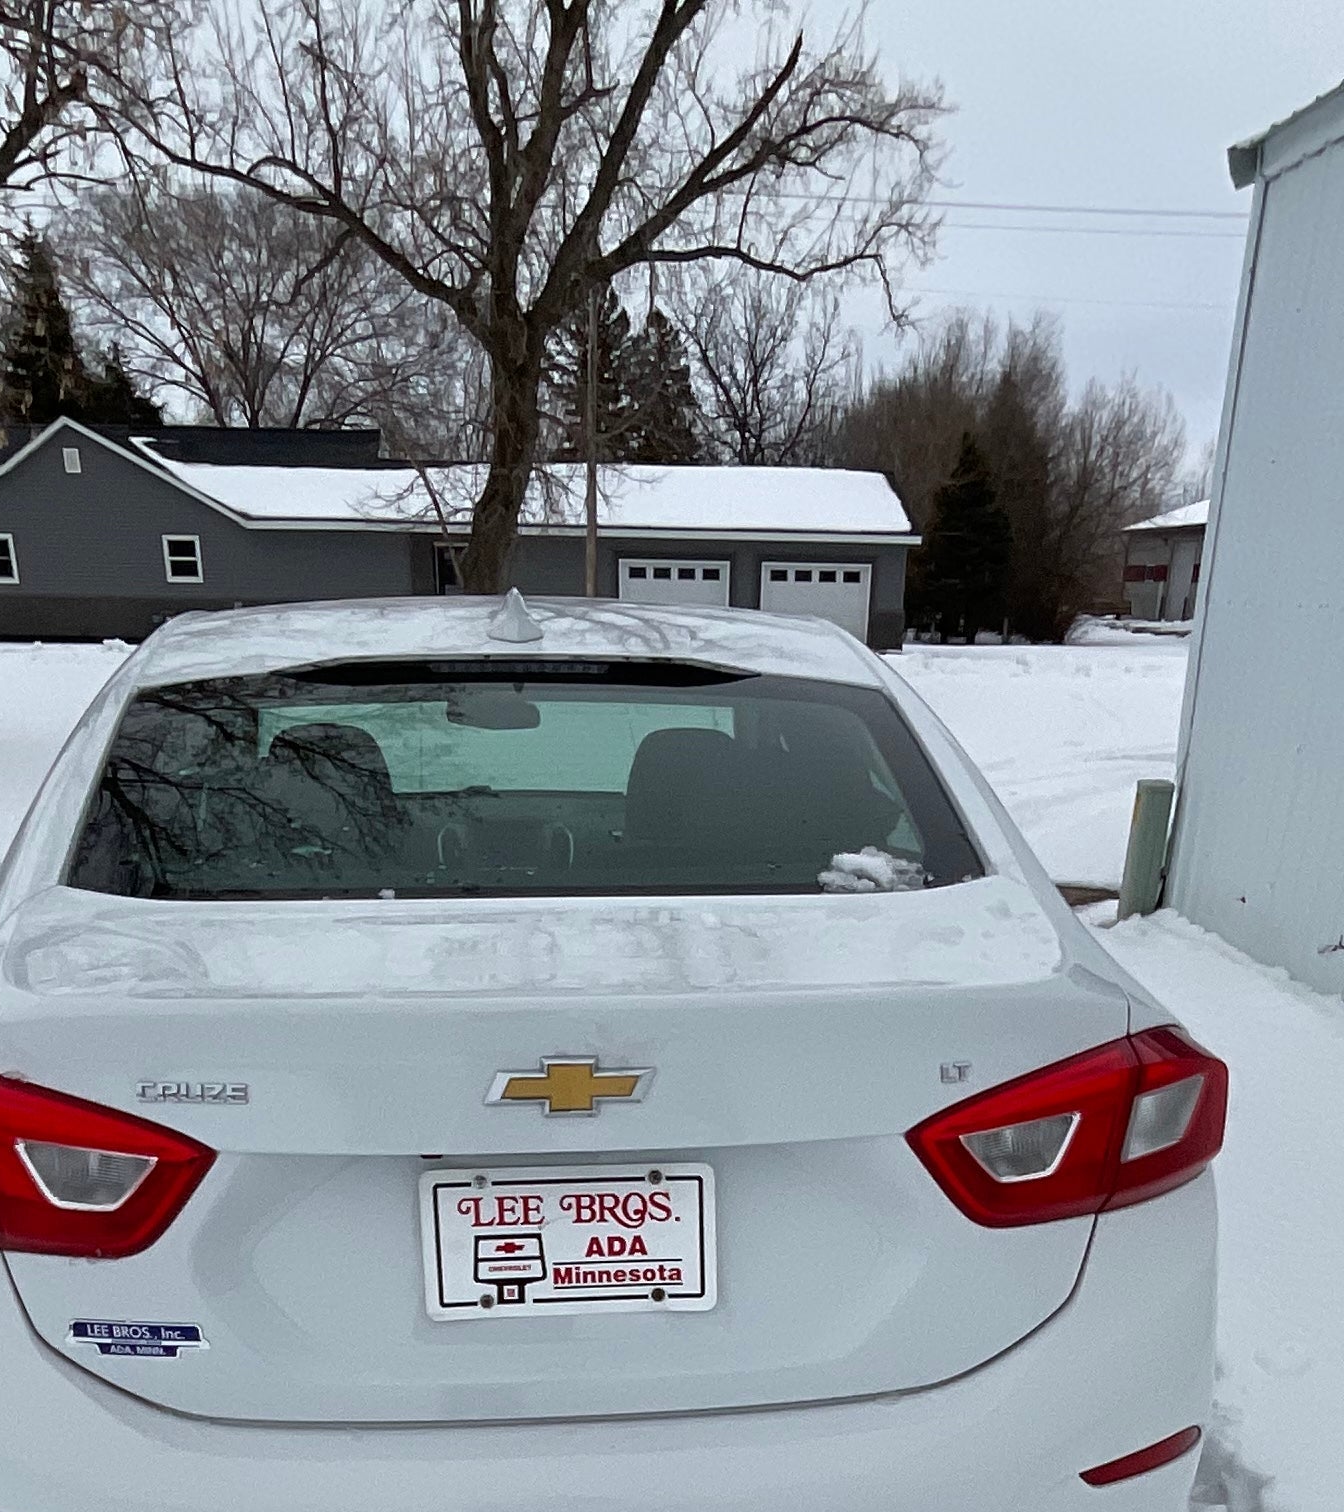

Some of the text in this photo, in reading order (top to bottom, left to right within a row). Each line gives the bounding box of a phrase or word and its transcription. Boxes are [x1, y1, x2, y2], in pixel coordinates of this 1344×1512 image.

[940, 1061, 972, 1083] LT
[136, 1081, 249, 1104] CRUZE
[457, 1191, 681, 1229] LEE BROS.
[585, 1235, 648, 1258] ADA
[553, 1265, 683, 1286] Minnesota
[86, 1324, 109, 1337] LEE
[160, 1327, 186, 1340] Inc.
